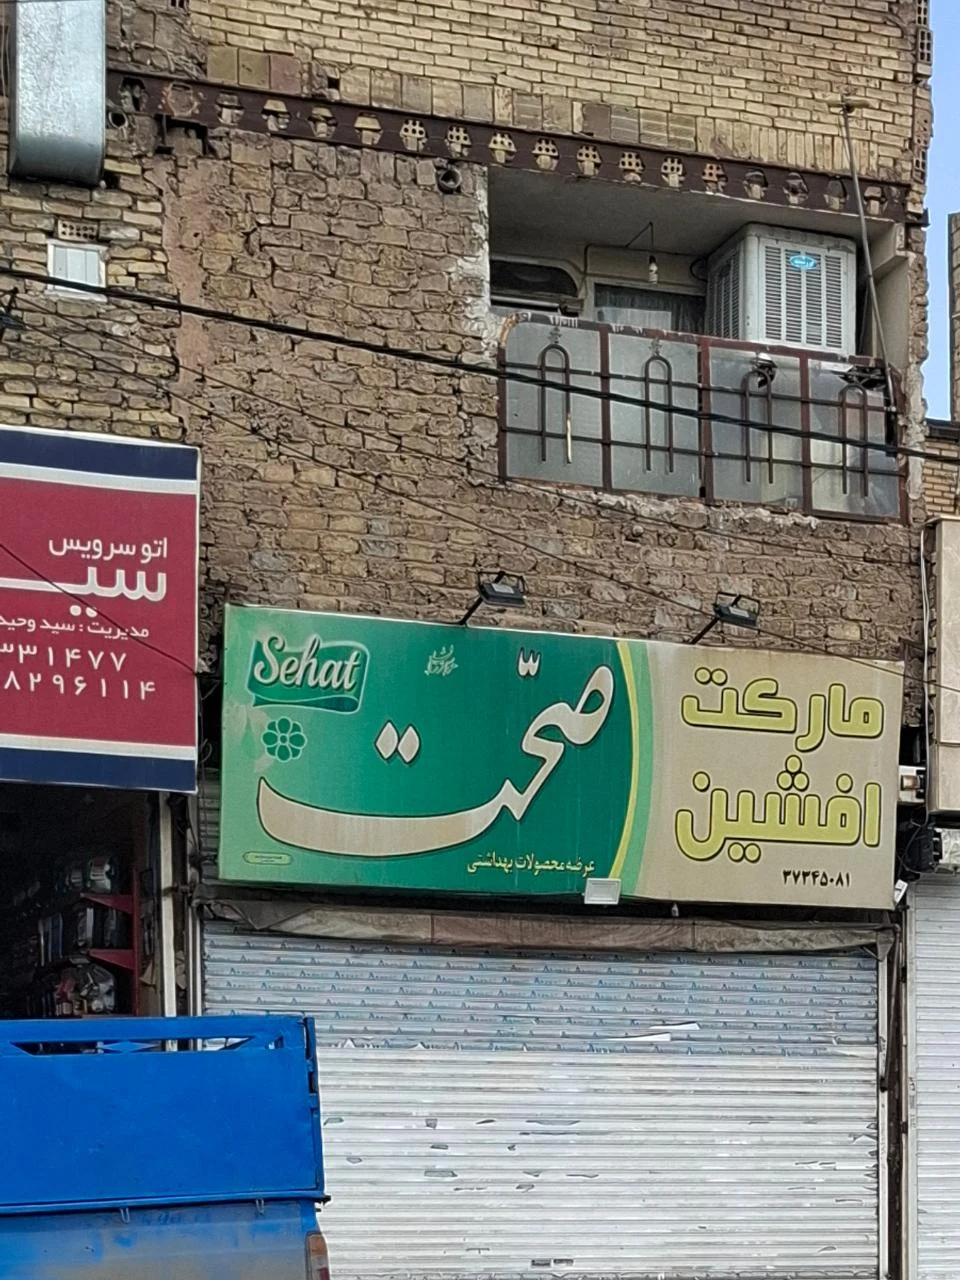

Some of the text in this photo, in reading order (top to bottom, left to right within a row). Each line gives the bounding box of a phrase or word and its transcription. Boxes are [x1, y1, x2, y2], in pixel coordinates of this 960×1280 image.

[49, 537, 168, 564] اتو سرویس
[40, 618, 75, 634] سید
[87, 621, 150, 640] مدیریت
[253, 634, 362, 691] Sehat
[681, 667, 884, 753] مارکت
[674, 754, 882, 864] افشین
[467, 851, 595, 878] عرضه محصولات بهداشتی
